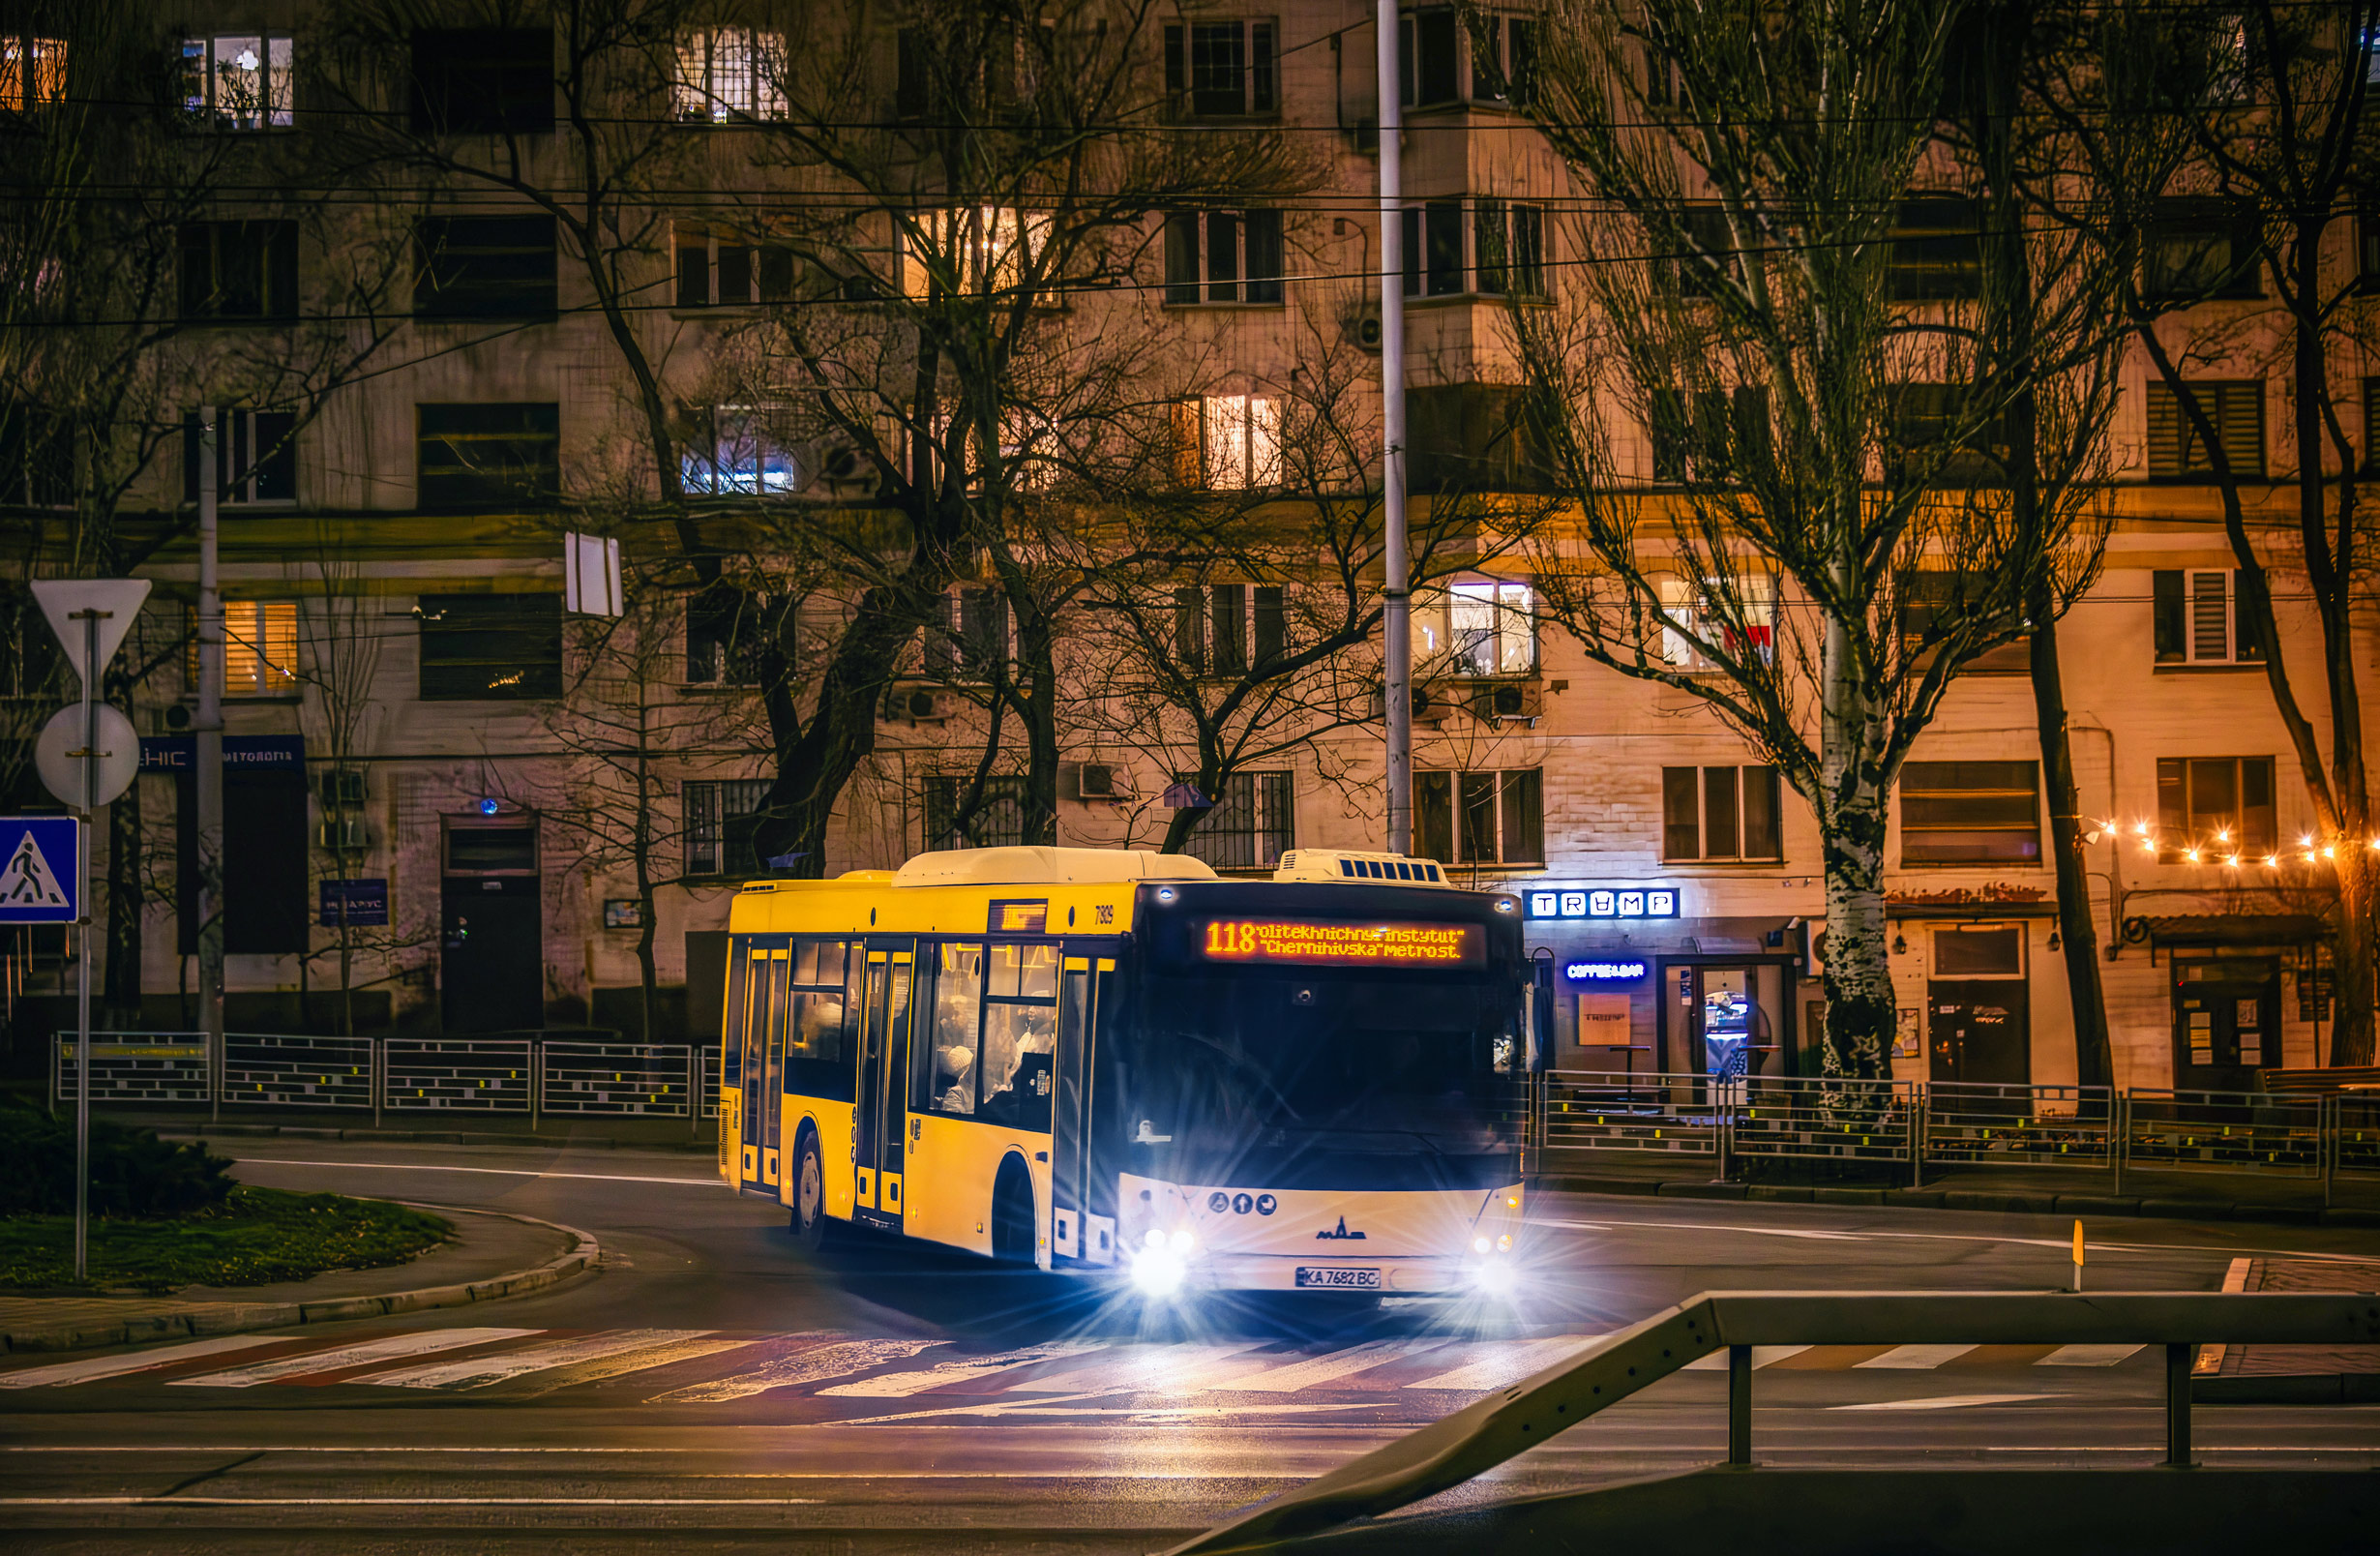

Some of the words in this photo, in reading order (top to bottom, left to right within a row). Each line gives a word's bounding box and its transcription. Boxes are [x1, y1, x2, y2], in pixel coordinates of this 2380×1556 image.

[1536, 895, 1670, 913] TRUMP
[1205, 921, 1256, 953] 118
[1304, 1271, 1324, 1284] KA
[1325, 1271, 1356, 1285] 7682
[1356, 1272, 1377, 1286] BC
